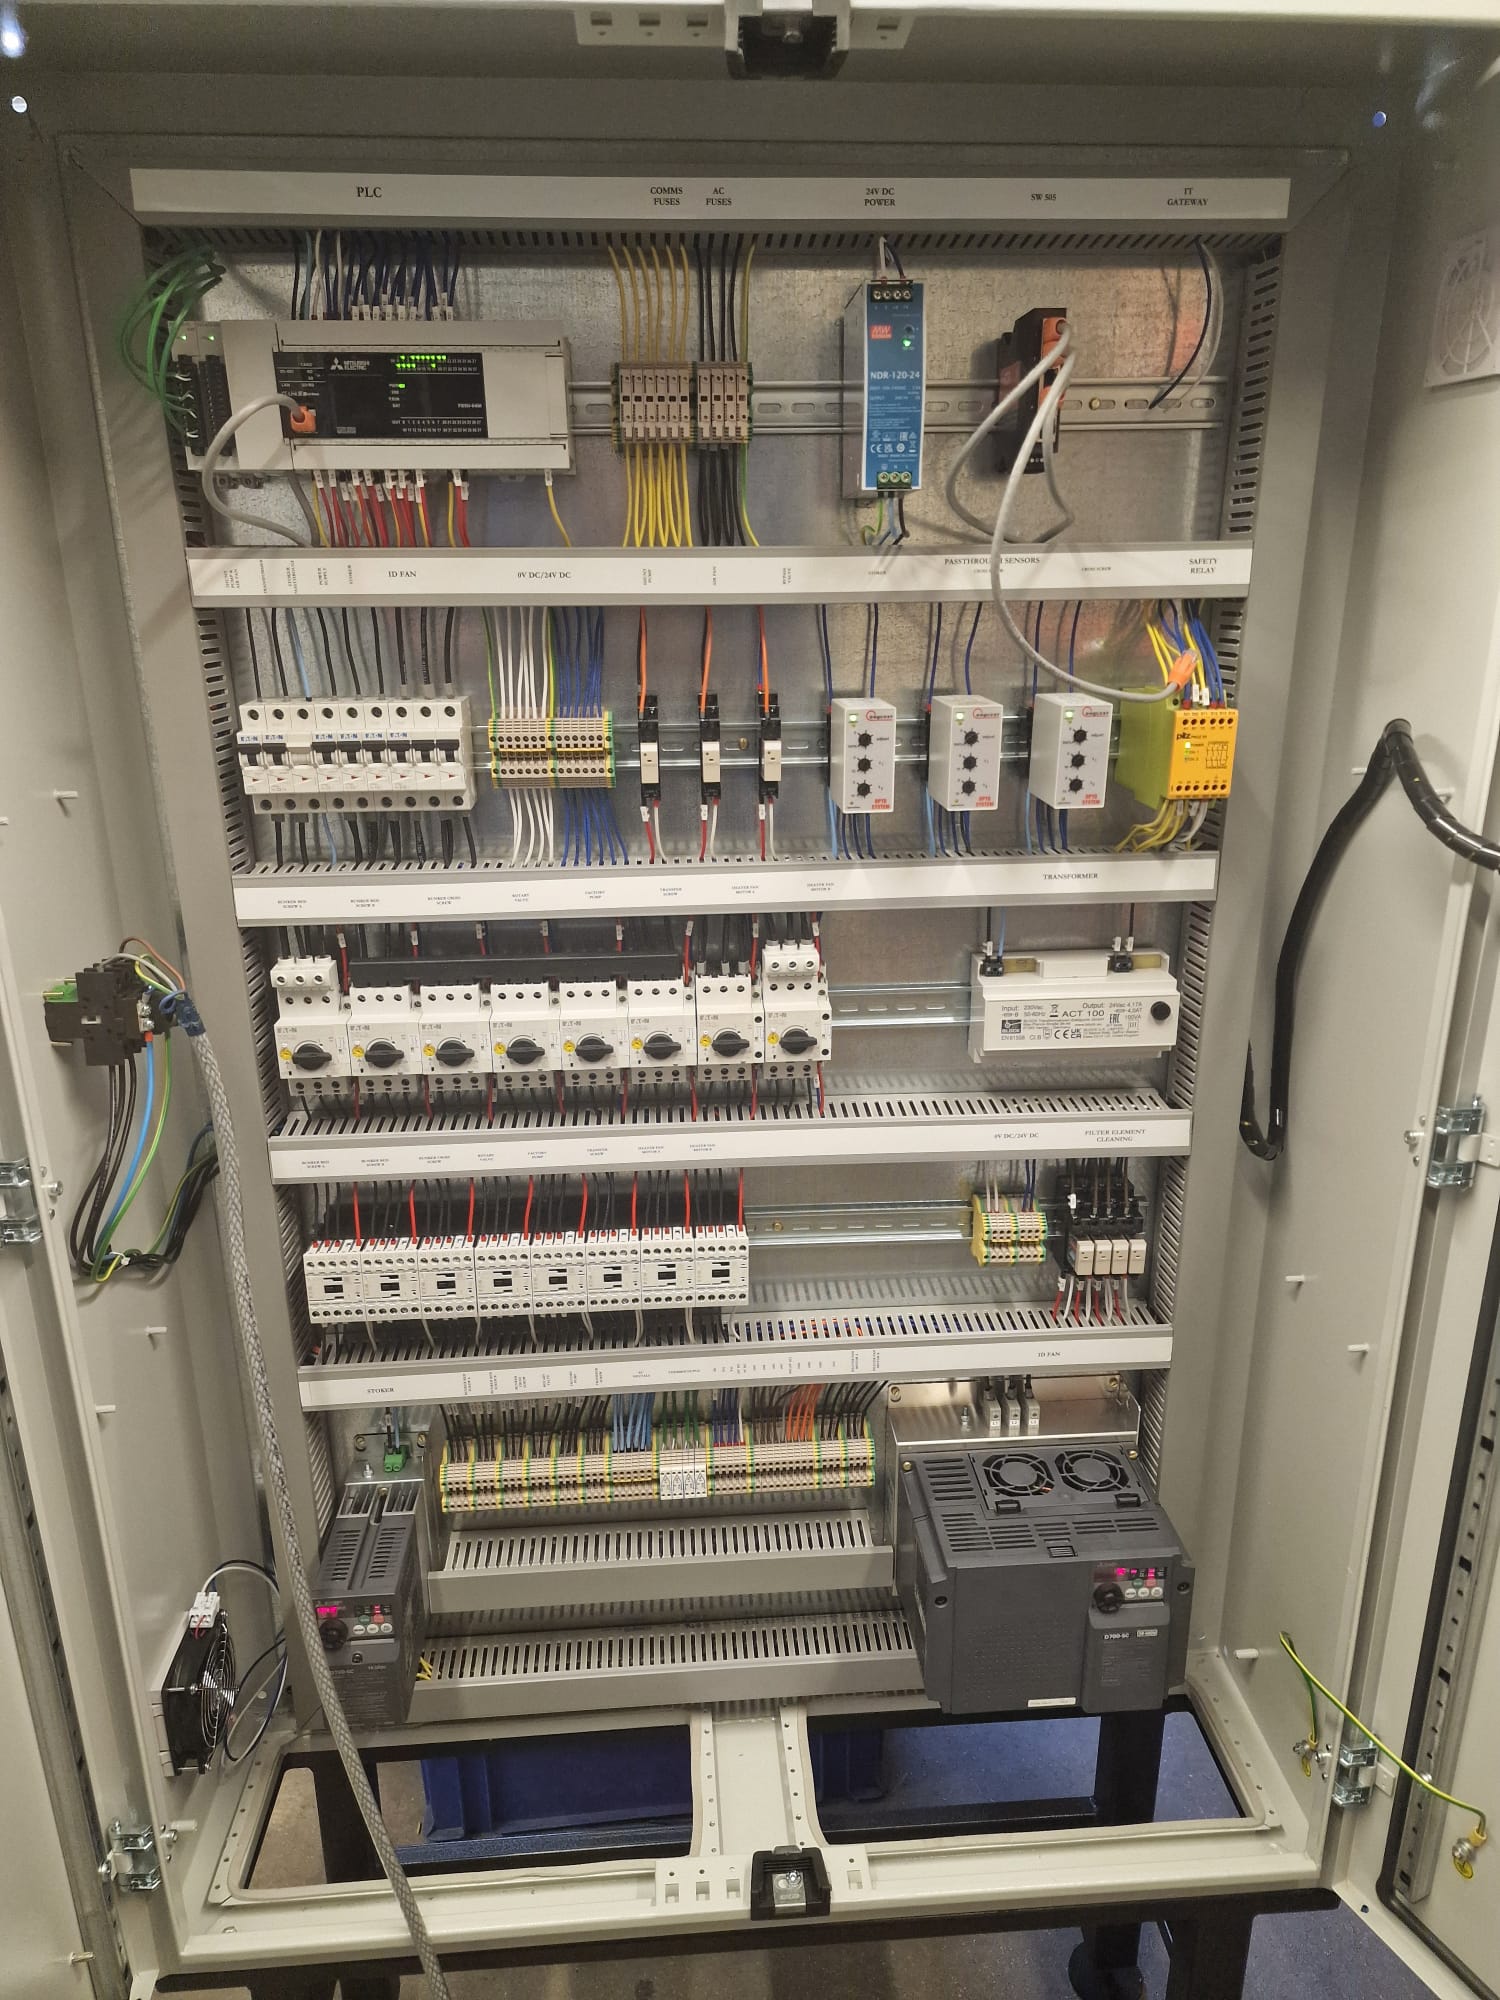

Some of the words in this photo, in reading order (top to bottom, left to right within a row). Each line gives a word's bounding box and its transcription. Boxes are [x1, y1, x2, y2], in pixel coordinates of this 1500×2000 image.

[356, 186, 382, 198] PLC
[650, 186, 683, 195] COMMS
[712, 187, 725, 195] AC
[865, 187, 879, 196] 24V
[882, 187, 895, 196] DC
[1184, 187, 1193, 195] IT
[1030, 193, 1043, 201] SW
[654, 197, 681, 206] FUSES
[705, 197, 732, 206] FUSES
[864, 198, 896, 207] POWER
[1167, 198, 1208, 206] GATEWAY
[870, 371, 920, 380] NDR-120-24
[944, 558, 1003, 566] PASSTHROU
[1188, 558, 1217, 566] SAFETY
[388, 570, 398, 578] ID
[399, 570, 417, 578] FAN
[559, 571, 571, 579] DC
[1088, 1009, 1105, 1017] 100
